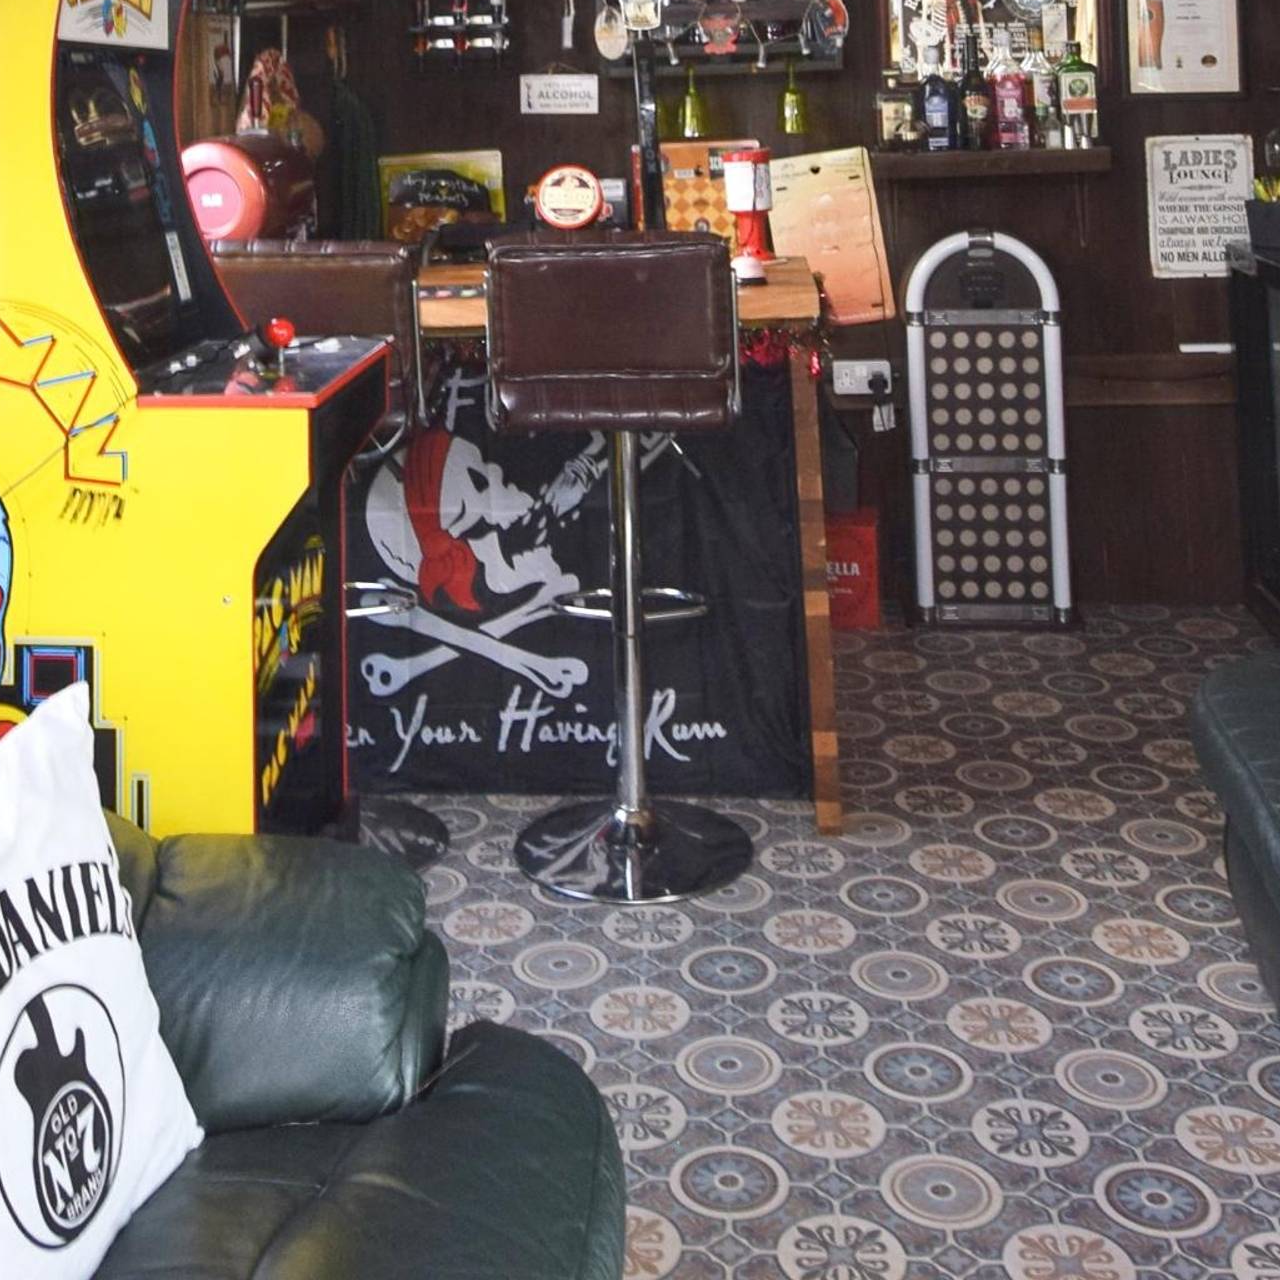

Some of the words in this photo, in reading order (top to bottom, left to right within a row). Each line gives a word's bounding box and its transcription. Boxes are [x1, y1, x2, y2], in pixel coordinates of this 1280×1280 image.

[538, 90, 594, 100] ALCOHOL
[1162, 149, 1238, 171] LADIES
[1169, 169, 1233, 185] LOUNGE
[1170, 214, 1220, 224] ALWAYS
[1160, 251, 1175, 263] NO
[1177, 251, 1199, 262] MEN
[825, 561, 861, 578] ELLA
[345, 721, 376, 748] en
[388, 694, 482, 773] Your
[497, 684, 622, 767] Having
[644, 687, 727, 762] Rum
[51, 1092, 79, 1135] OLD
[66, 1165, 104, 1221] BRAND
